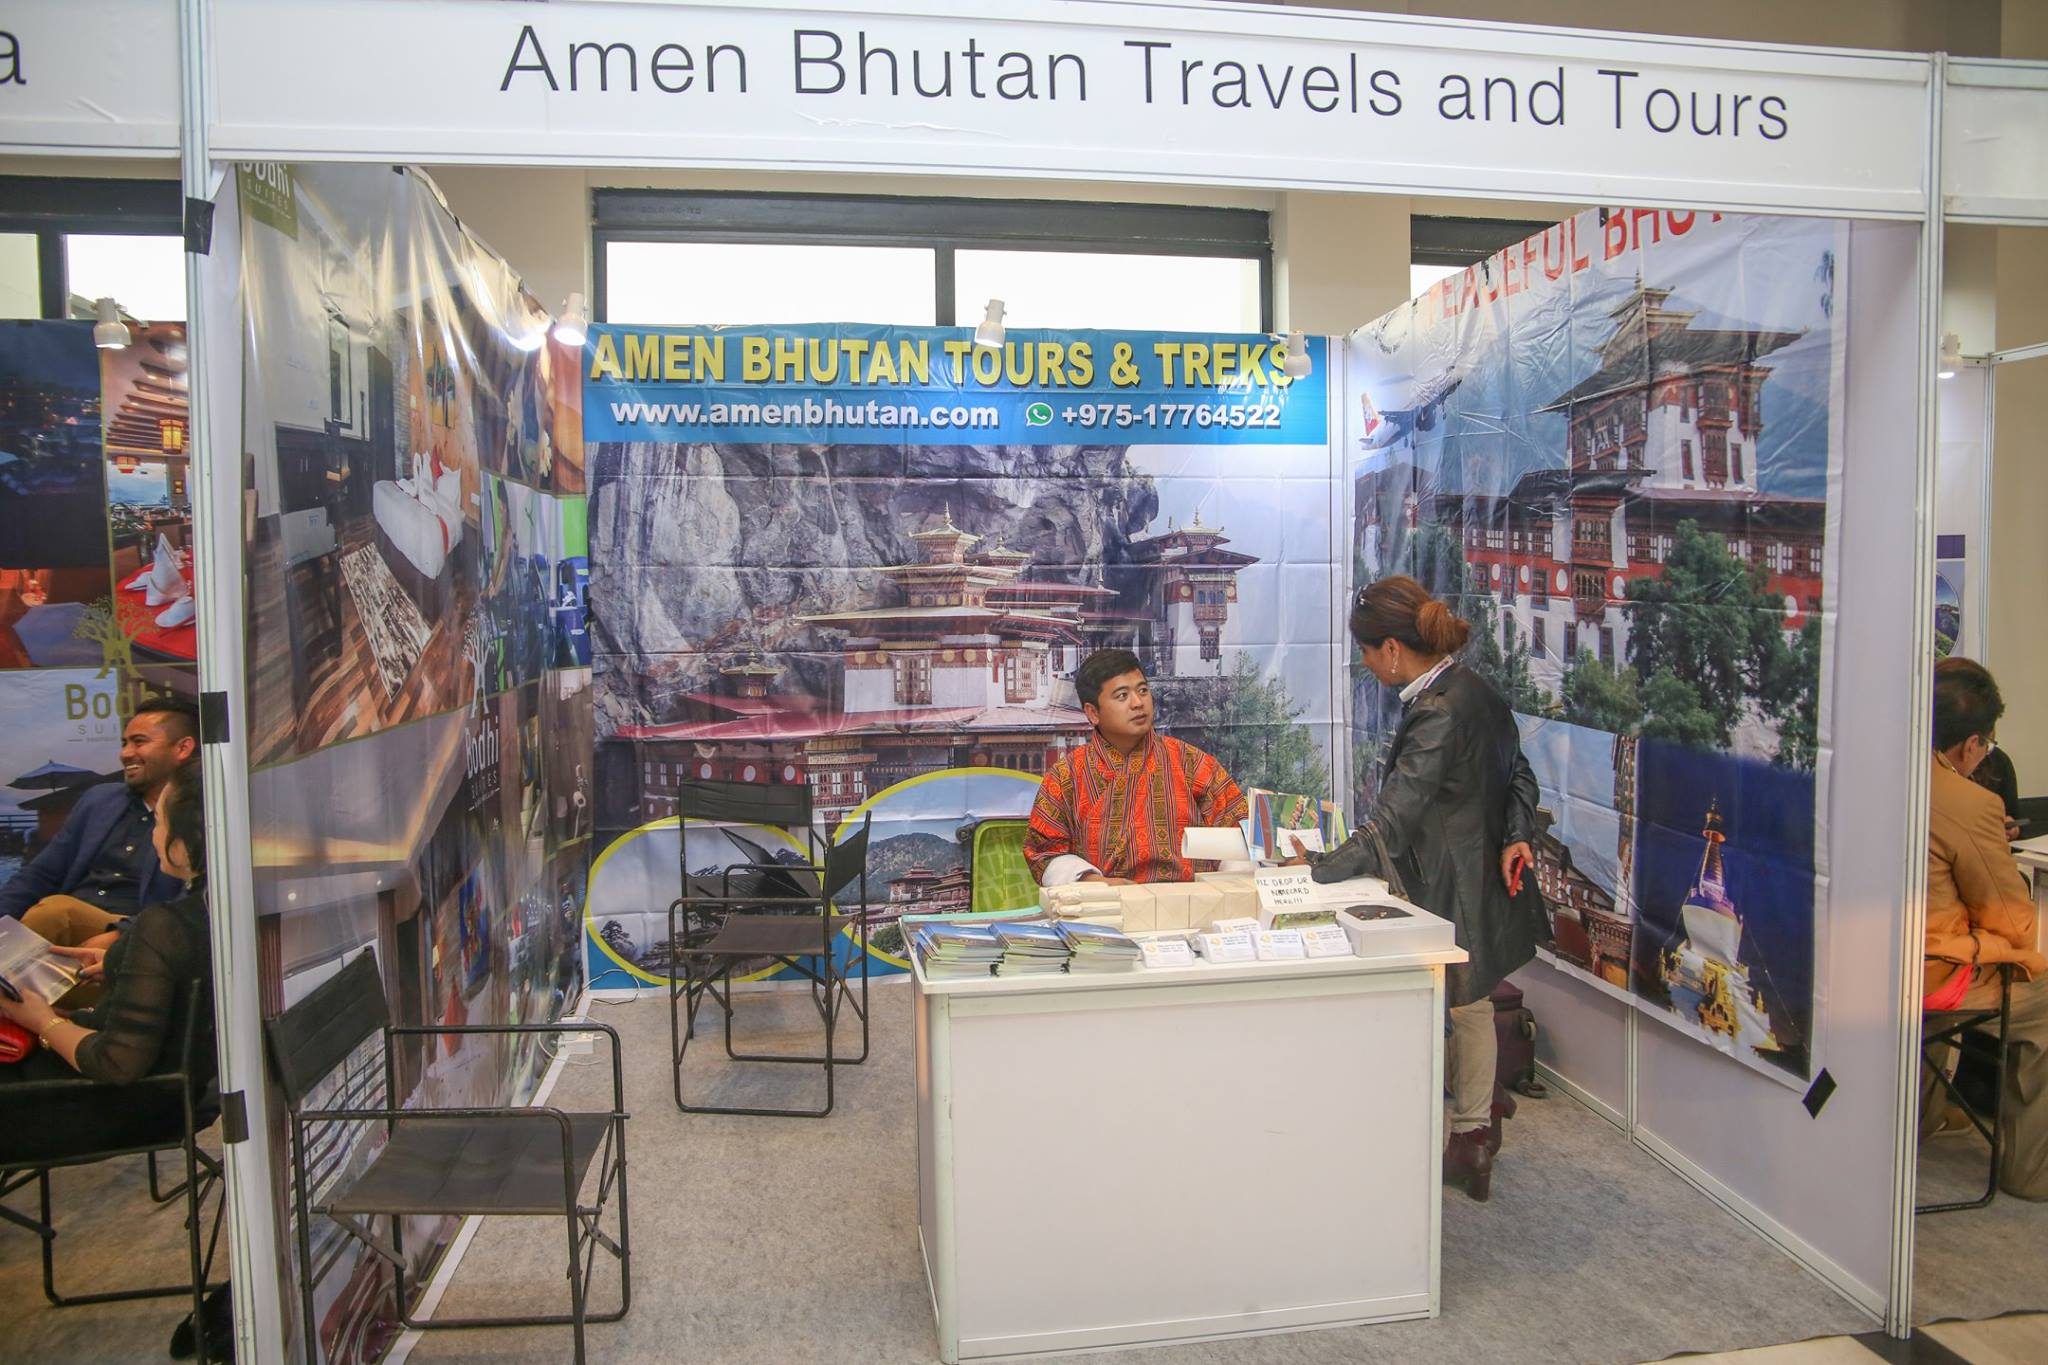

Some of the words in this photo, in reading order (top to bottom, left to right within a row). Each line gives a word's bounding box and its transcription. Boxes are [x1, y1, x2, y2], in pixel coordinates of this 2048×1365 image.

[500, 25, 748, 94] Amen
[794, 29, 1087, 102] Bhutan
[1123, 40, 1403, 117] Travels
[1437, 66, 1566, 127] and
[1596, 69, 1789, 141] Tours
[589, 333, 726, 382] AMEN
[742, 336, 930, 385] BHUTAN
[944, 340, 1095, 387] TOURS
[1110, 341, 1141, 387] &
[1154, 342, 1296, 388] TREKS
[610, 398, 1000, 428] www.amenbhutan.com
[1061, 403, 1282, 428] +975-17764522
[465, 715, 499, 779] Bodhi
